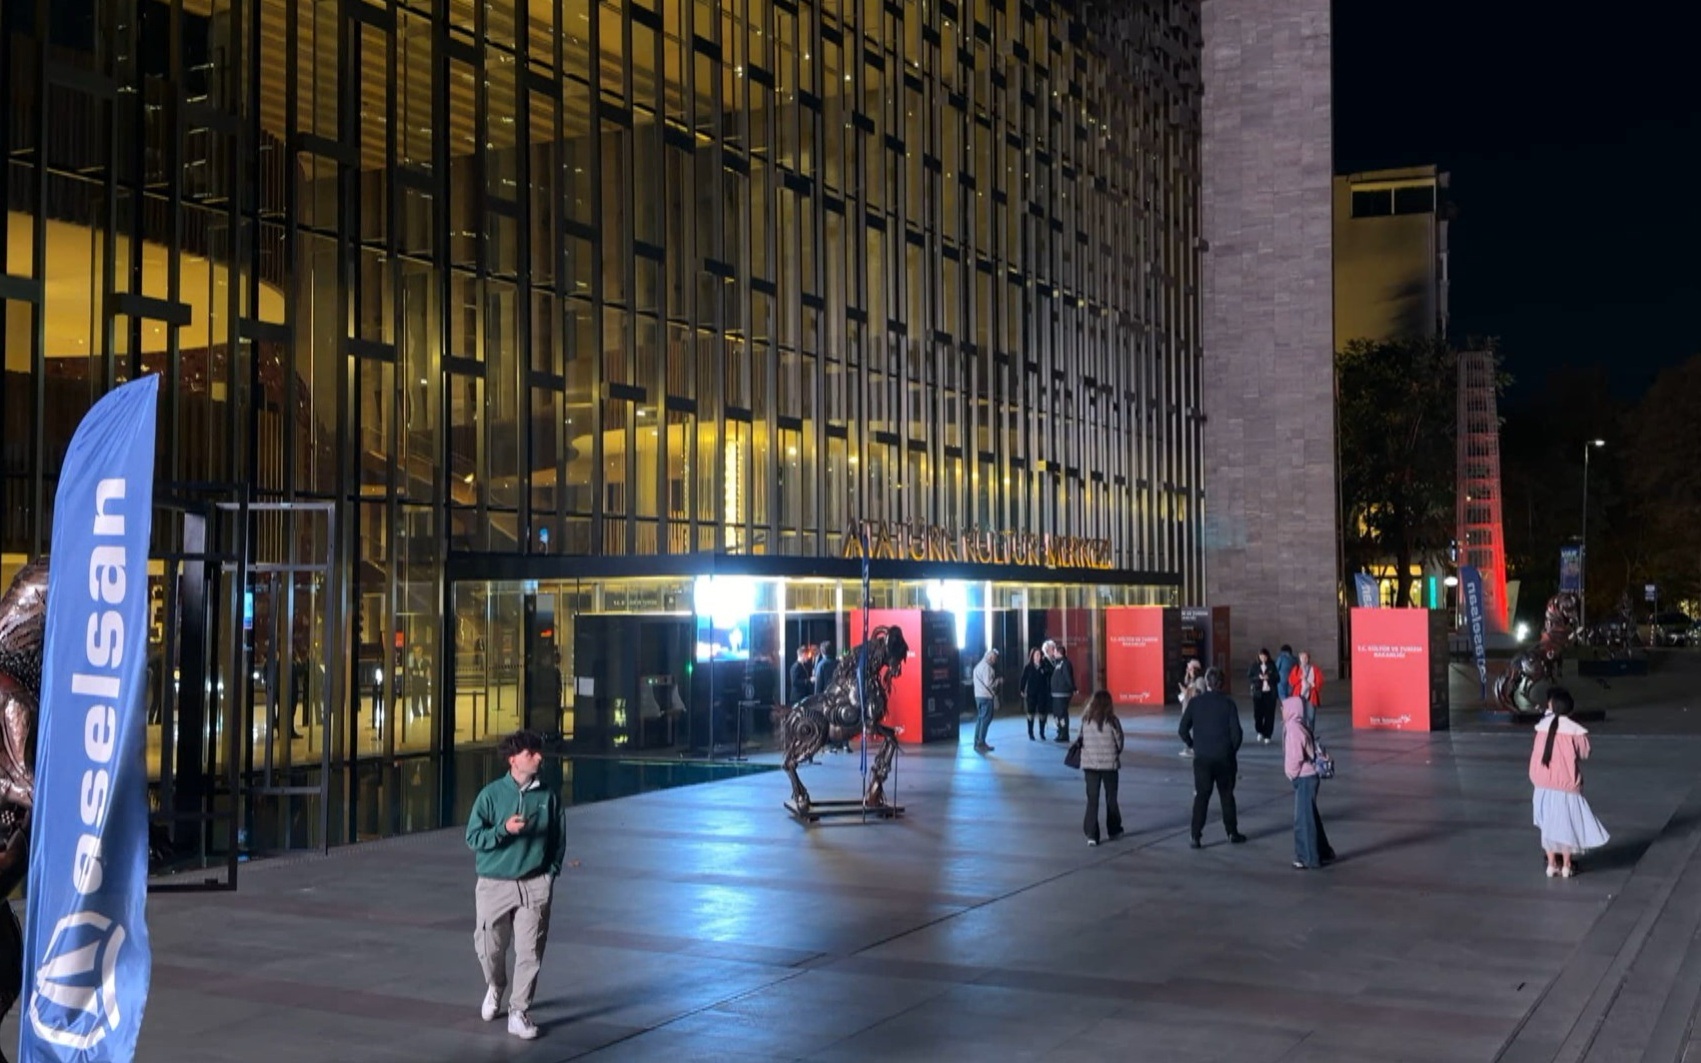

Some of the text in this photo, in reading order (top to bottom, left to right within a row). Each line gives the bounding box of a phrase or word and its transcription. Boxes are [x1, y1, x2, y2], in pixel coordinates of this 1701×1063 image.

[843, 516, 957, 562] ATATÜRK
[961, 523, 1039, 567] KÜLTÜR
[72, 477, 126, 896] aselsan
